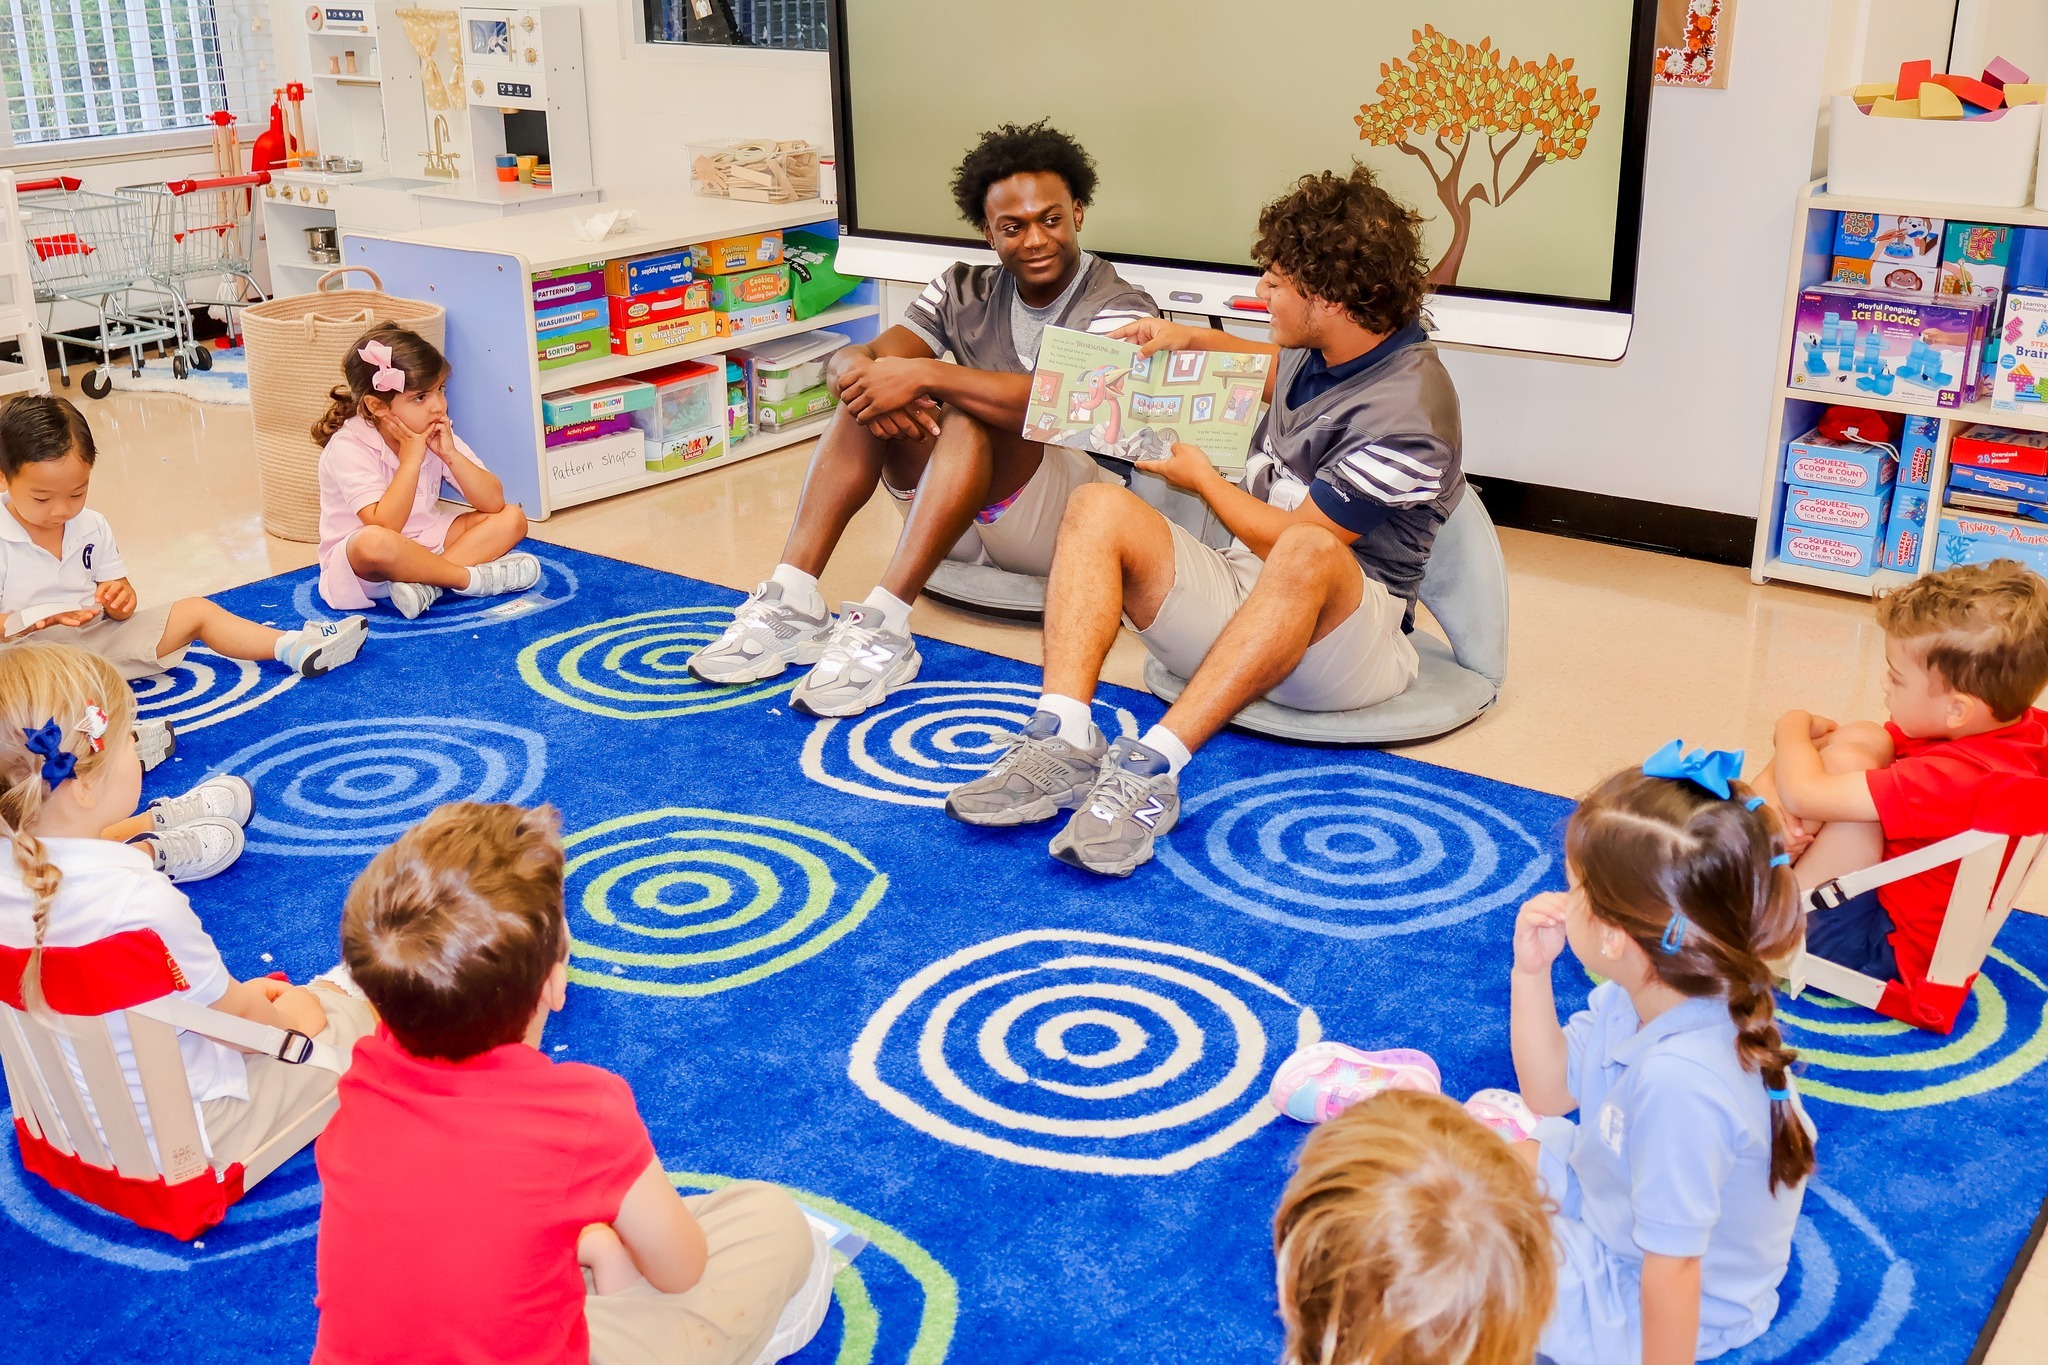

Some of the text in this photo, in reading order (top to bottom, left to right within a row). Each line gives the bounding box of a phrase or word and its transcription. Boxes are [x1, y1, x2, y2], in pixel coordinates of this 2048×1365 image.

[1844, 212, 1873, 221] Feed
[1852, 219, 1865, 227] the
[1844, 224, 1869, 237] Dog
[720, 245, 749, 255] Positional
[1967, 228, 1982, 260] Bunny
[1985, 230, 1998, 259] Feed
[726, 252, 745, 262] Words
[641, 266, 658, 276] Apples
[658, 262, 682, 272] Attribute
[1838, 268, 1866, 280] Feed
[750, 276, 774, 286] Cookies
[538, 286, 574, 298] PATTERNING
[1858, 302, 1917, 315] Playful Penguins
[2023, 300, 2047, 308] Learning
[538, 313, 580, 328] MEASUREMENT
[1852, 310, 1920, 326] ICE BLOCKS
[651, 326, 695, 340] What Comes
[665, 334, 686, 344] Next?
[548, 346, 574, 357] SORTING
[576, 342, 590, 350] Center
[1180, 354, 1196, 370] T
[1940, 392, 1955, 402] 34
[593, 398, 622, 410] RAINBOW
[1814, 458, 1848, 469] SQUEEZE,
[1912, 447, 1922, 482] TWEEZER
[1978, 454, 1991, 464] 28
[552, 460, 594, 481] Pattern
[1798, 463, 1826, 472] SCOOP
[1835, 468, 1863, 478] COUNT
[1918, 454, 1926, 478] TONGS
[1839, 476, 1856, 484] Shop
[1815, 498, 1850, 510] SQUEEZE,
[1800, 504, 1826, 513] SCOOP
[1837, 510, 1864, 519] COUNT
[1958, 521, 1997, 535] Fishing
[2009, 526, 2048, 546] Phonics
[1808, 536, 1843, 548] SQUEEZE,
[1898, 531, 1908, 566] TWEEZER
[1793, 542, 1820, 551] SCOOP
[1830, 548, 1857, 558] COUNT
[1903, 538, 1912, 560] TONGS
[82, 543, 95, 571] G
[1810, 552, 1832, 560] Cream
[1833, 556, 1850, 564] Shop
[321, 624, 337, 637] N
[1132, 794, 1166, 829] N
